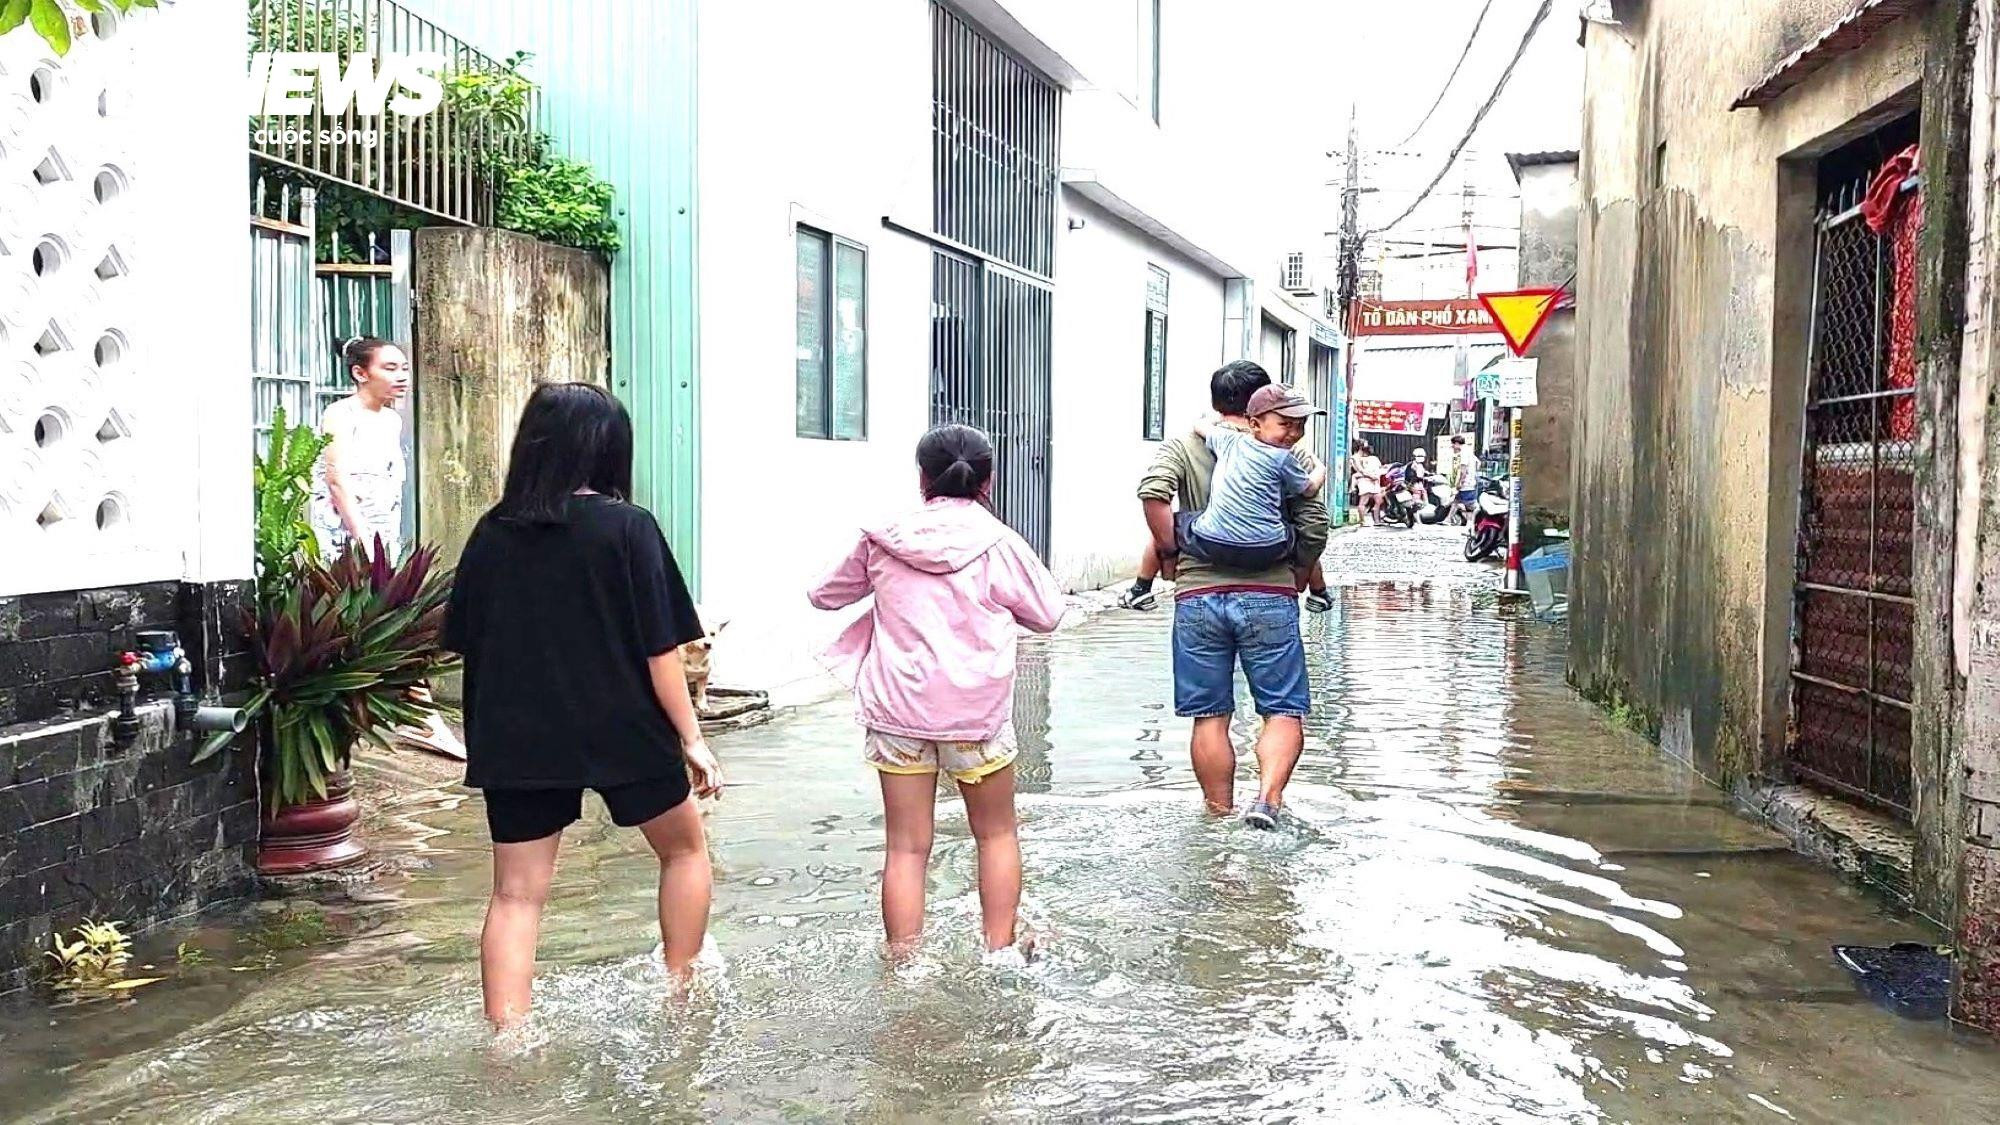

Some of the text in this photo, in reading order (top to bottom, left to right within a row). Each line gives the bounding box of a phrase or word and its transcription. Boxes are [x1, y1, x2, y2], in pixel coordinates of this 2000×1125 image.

[1362, 305, 1382, 327] TỔ
[1385, 308, 1418, 326] DÂN
[1421, 304, 1452, 326] PHỐ
